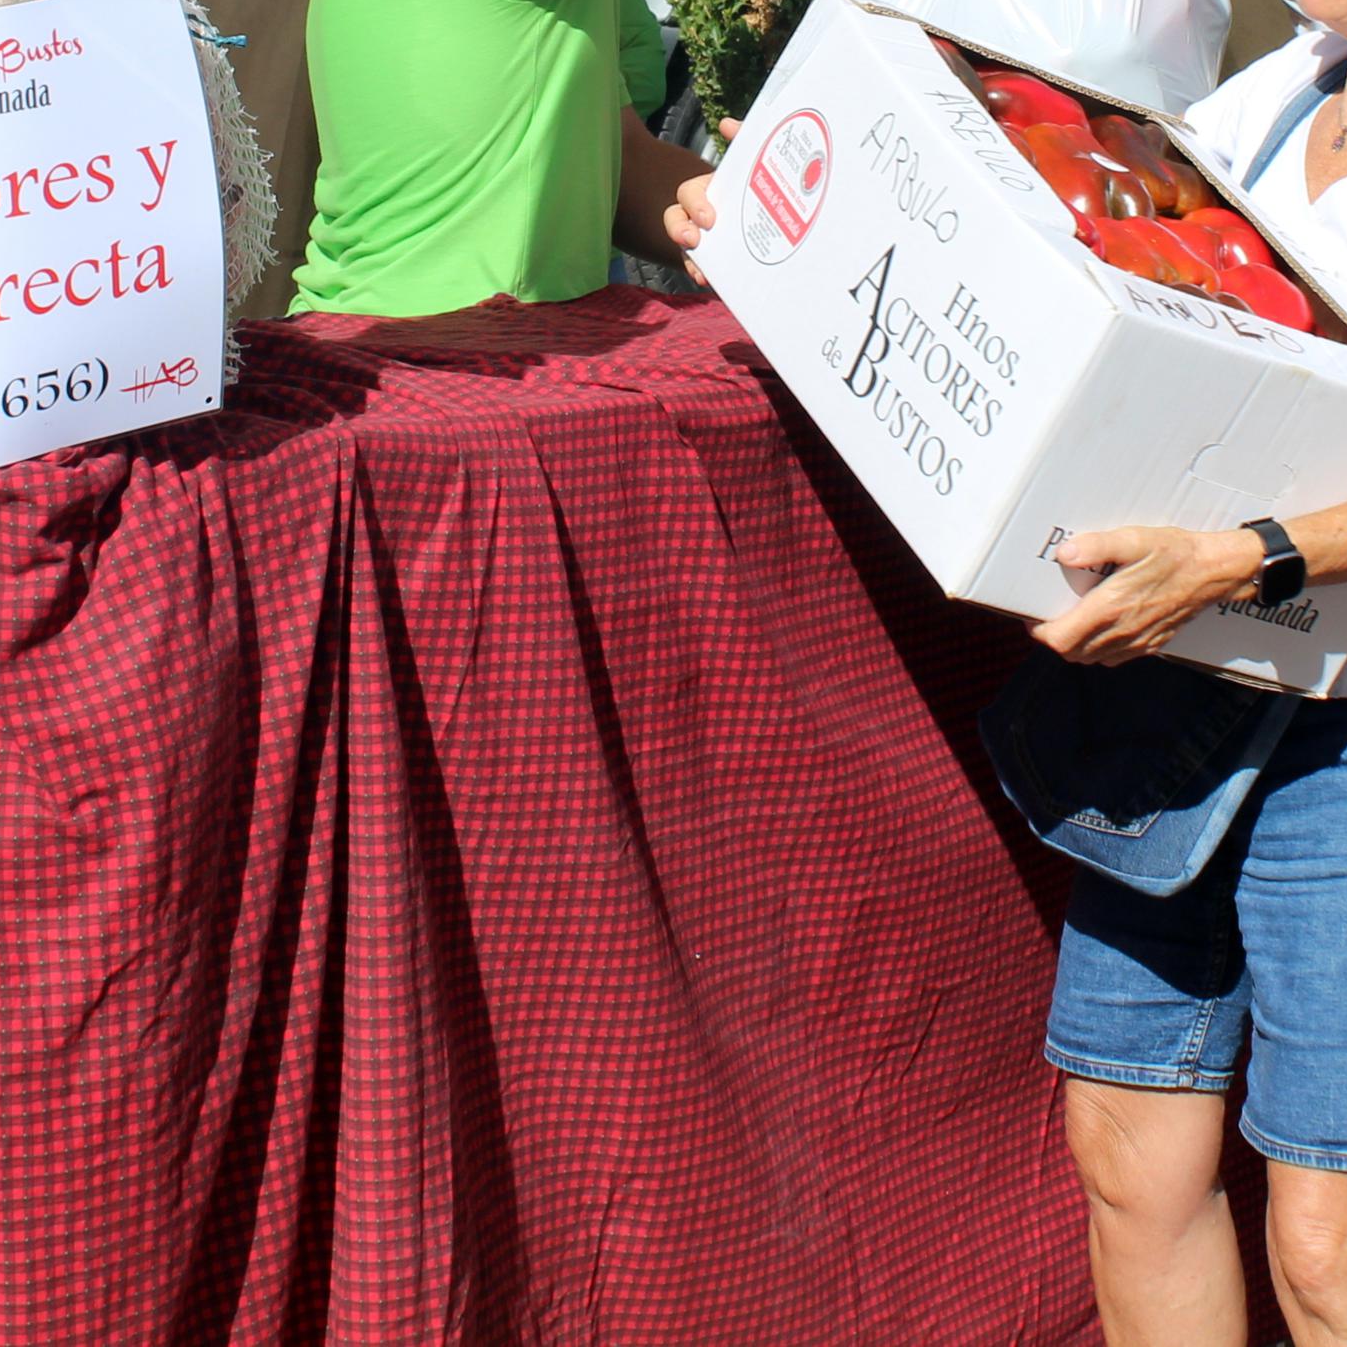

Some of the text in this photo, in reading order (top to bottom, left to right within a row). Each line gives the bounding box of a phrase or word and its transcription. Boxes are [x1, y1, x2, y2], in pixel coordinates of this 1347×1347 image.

[136, 139, 179, 212] y
[847, 243, 1003, 438] ACITORES
[942, 281, 1020, 387] Hnos.
[0, 357, 111, 419] 656)
[820, 314, 964, 497] de BUSTOS
[1216, 597, 1321, 635] quemada
